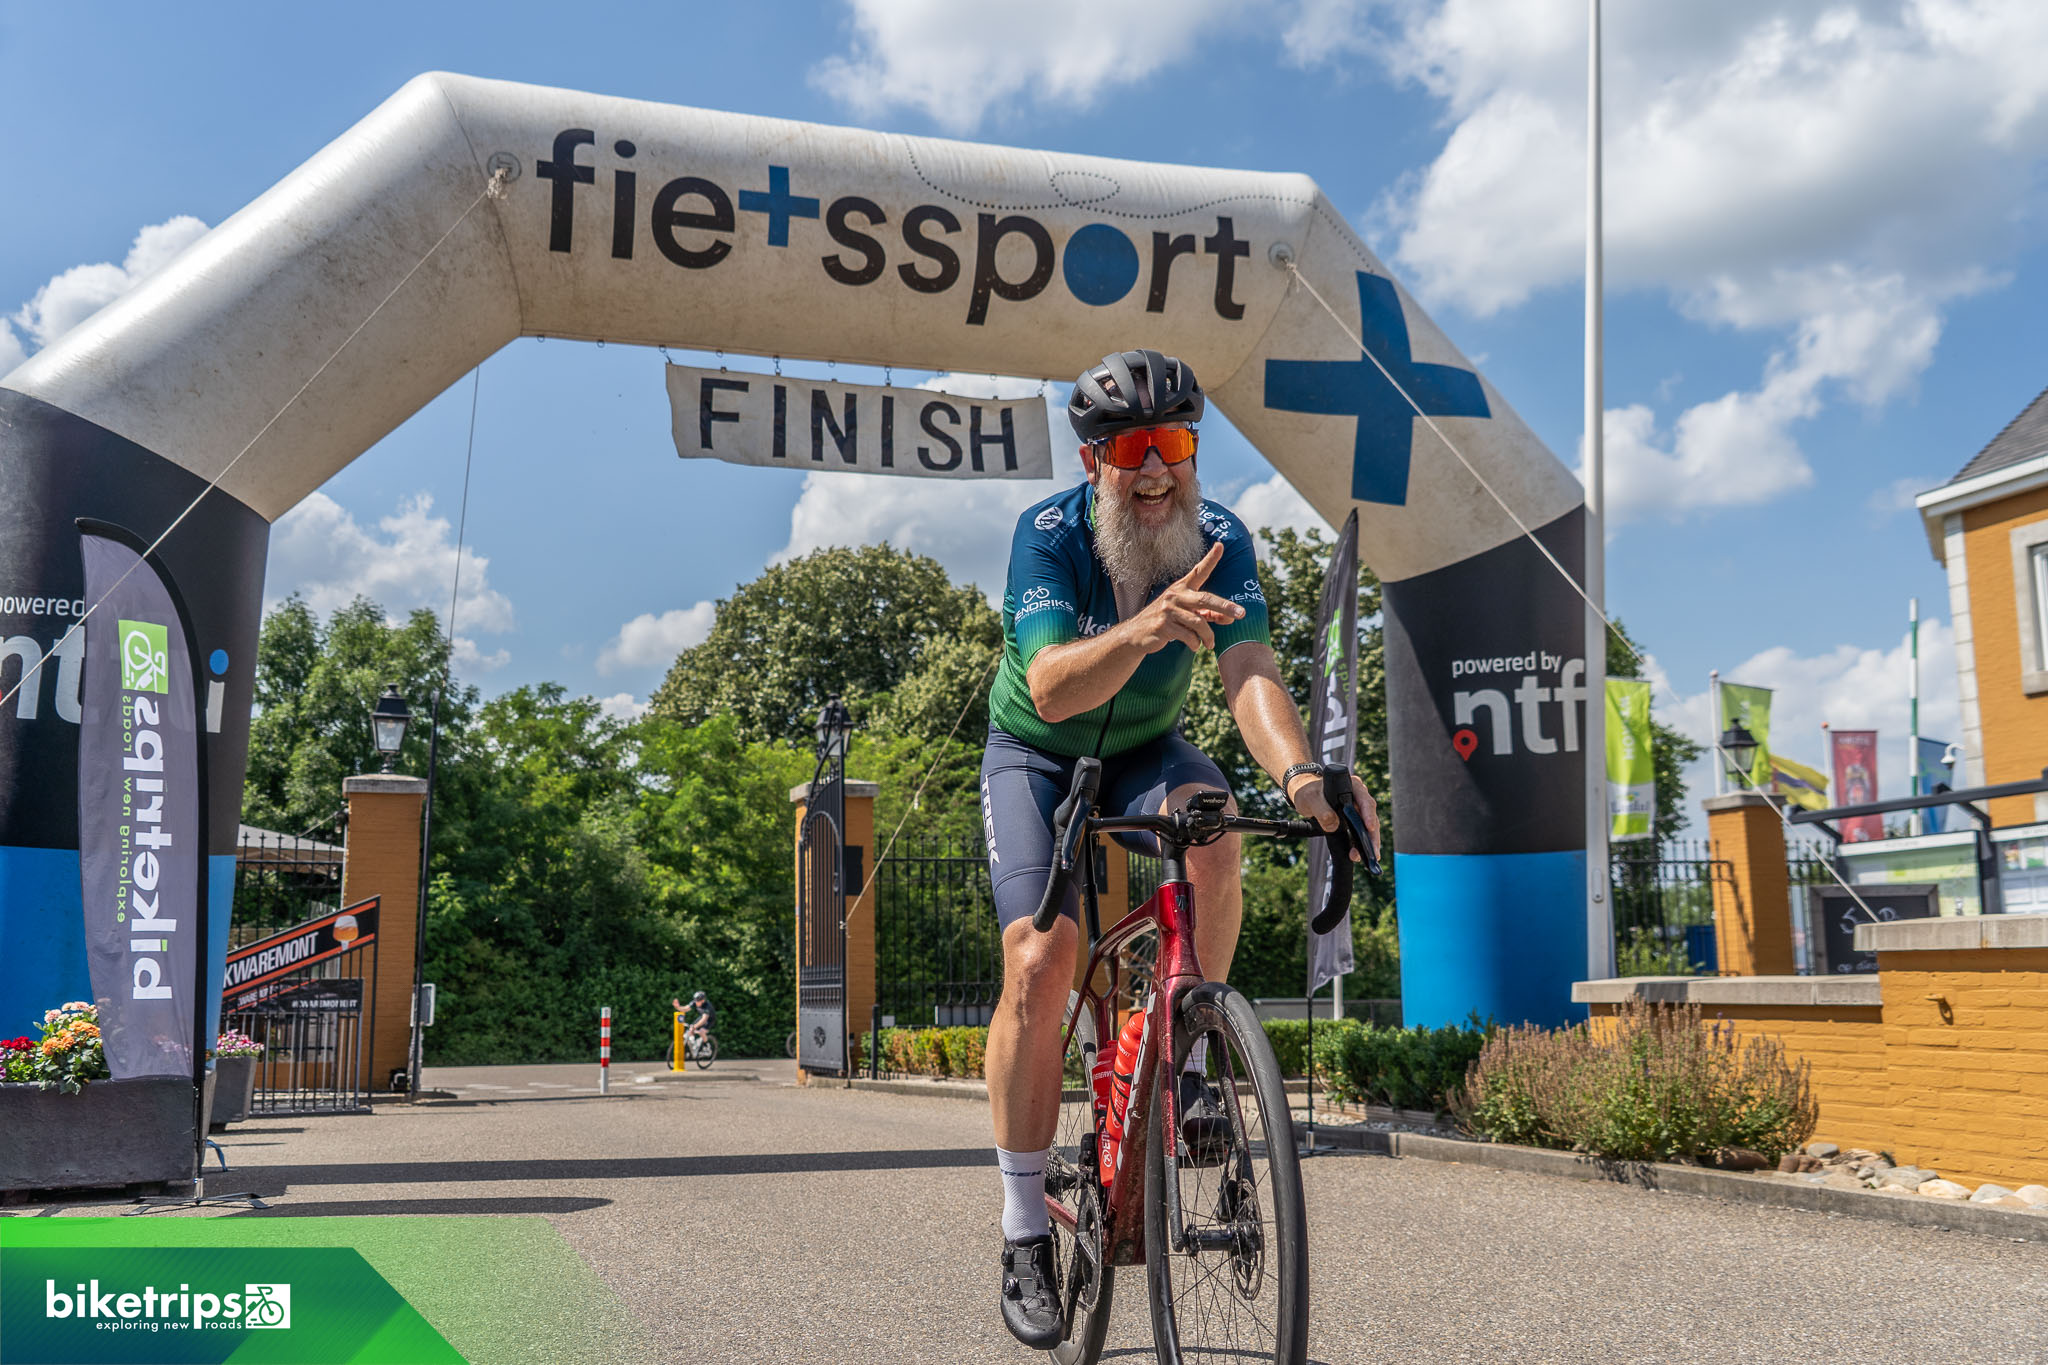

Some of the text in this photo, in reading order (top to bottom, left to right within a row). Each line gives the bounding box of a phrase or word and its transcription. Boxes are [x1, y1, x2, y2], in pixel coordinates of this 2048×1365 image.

[700, 377, 1018, 471] FINISH
[1452, 650, 1562, 678] powered by
[982, 774, 1000, 868] TREK
[223, 931, 319, 988] KWAREMONT
